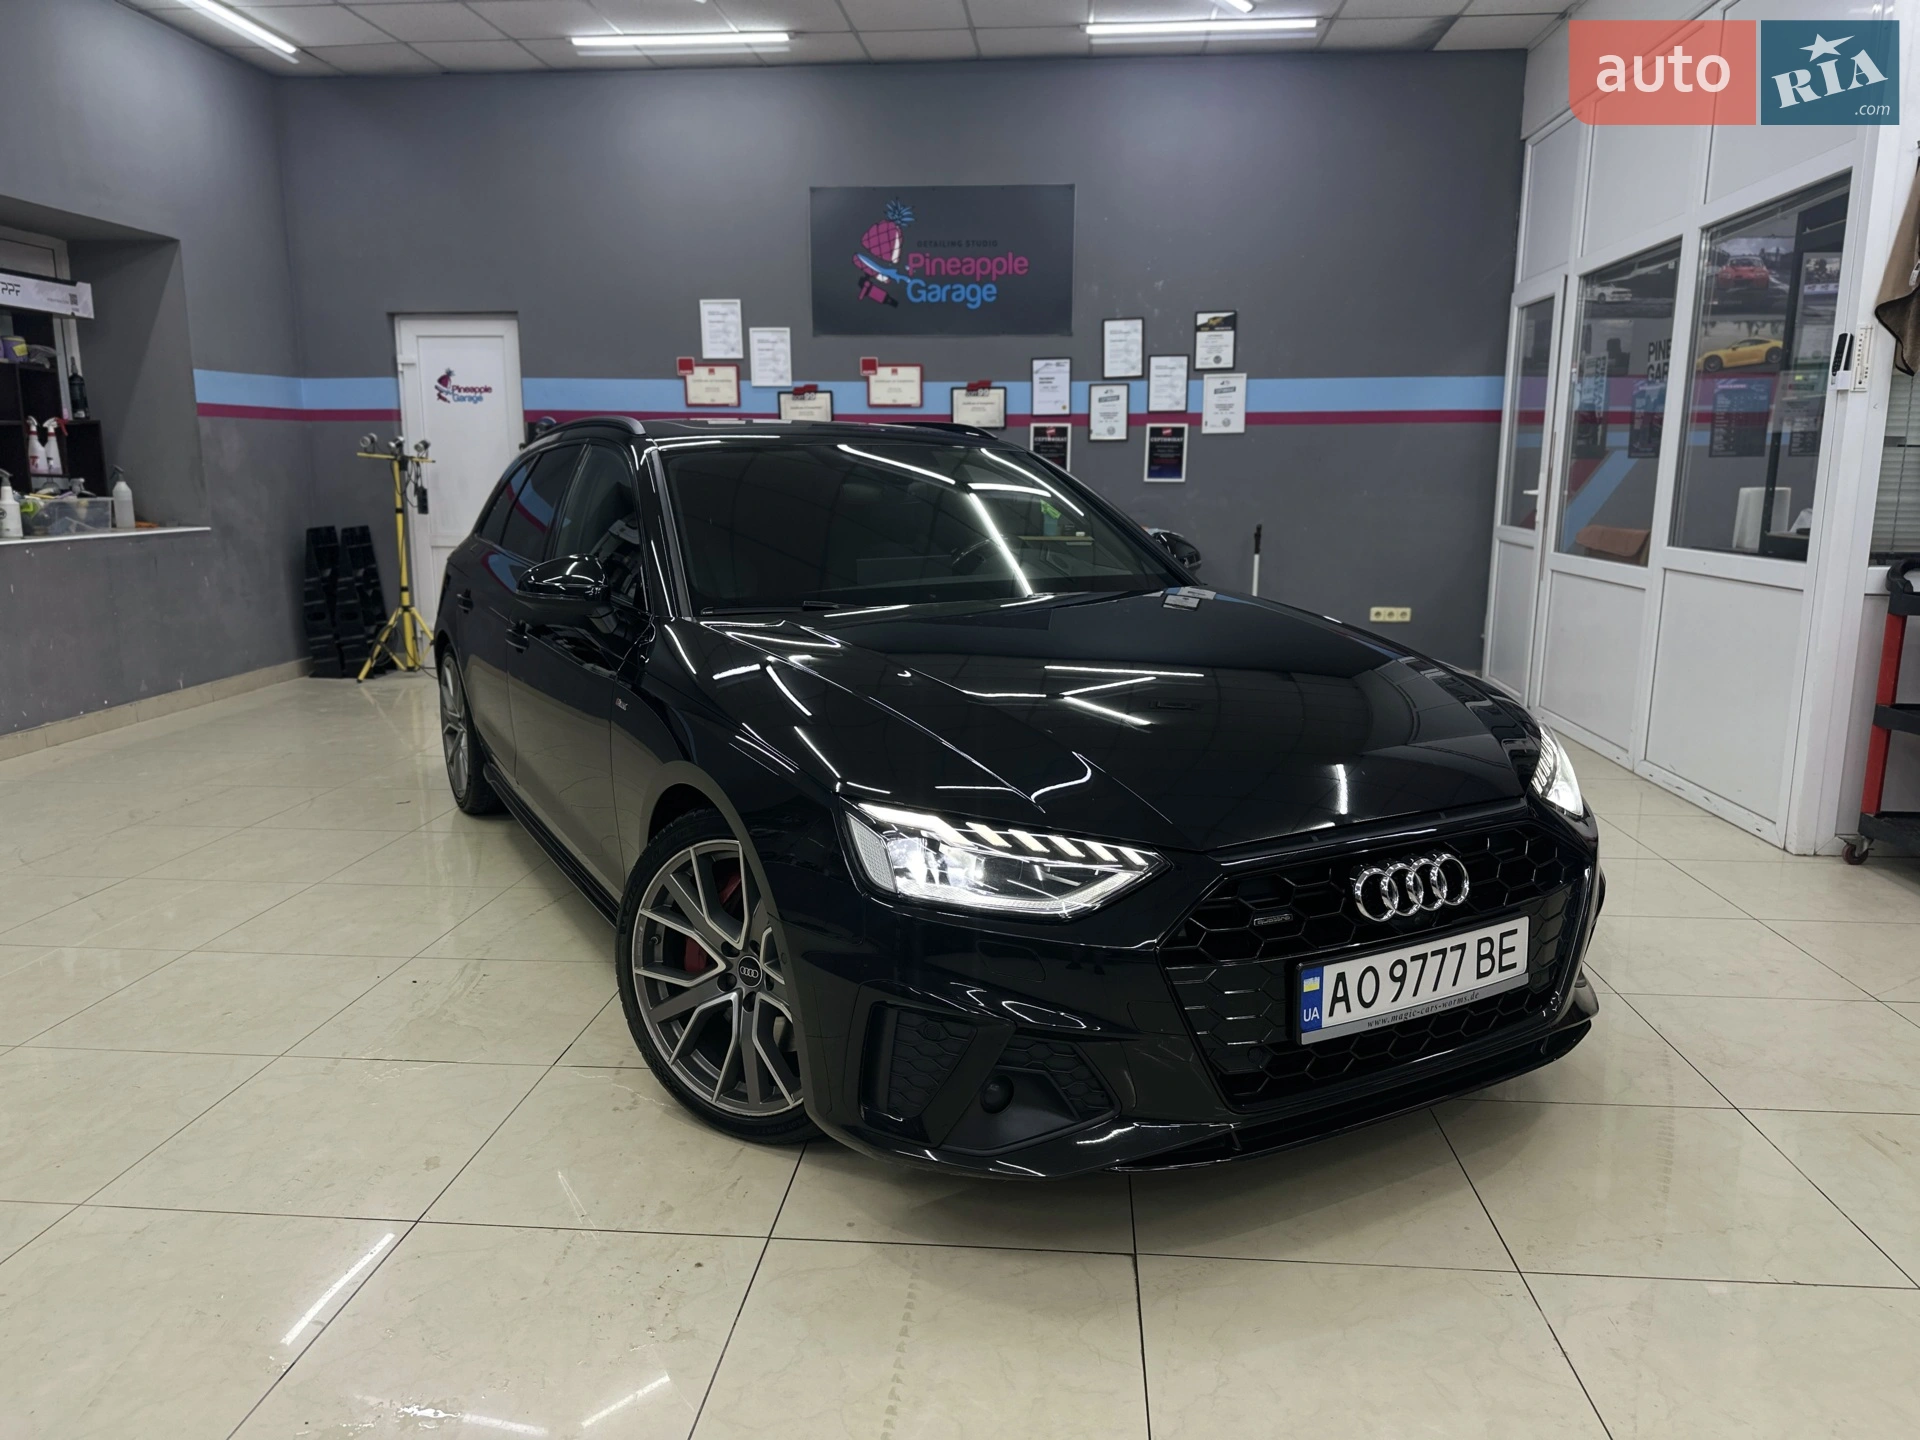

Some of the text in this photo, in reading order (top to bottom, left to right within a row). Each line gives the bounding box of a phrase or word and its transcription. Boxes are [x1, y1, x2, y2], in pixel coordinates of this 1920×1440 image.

[916, 240, 998, 248] DETAILING STUDIO
[908, 252, 1029, 282] Pineapple
[906, 279, 998, 309] Garage
[452, 385, 492, 395] Pineapple
[453, 393, 484, 404] Garage
[1328, 928, 1518, 1018] AO 9777 BE
[1303, 1007, 1320, 1023] UA
[1367, 991, 1480, 1028] www.magic-cars-worms.de
